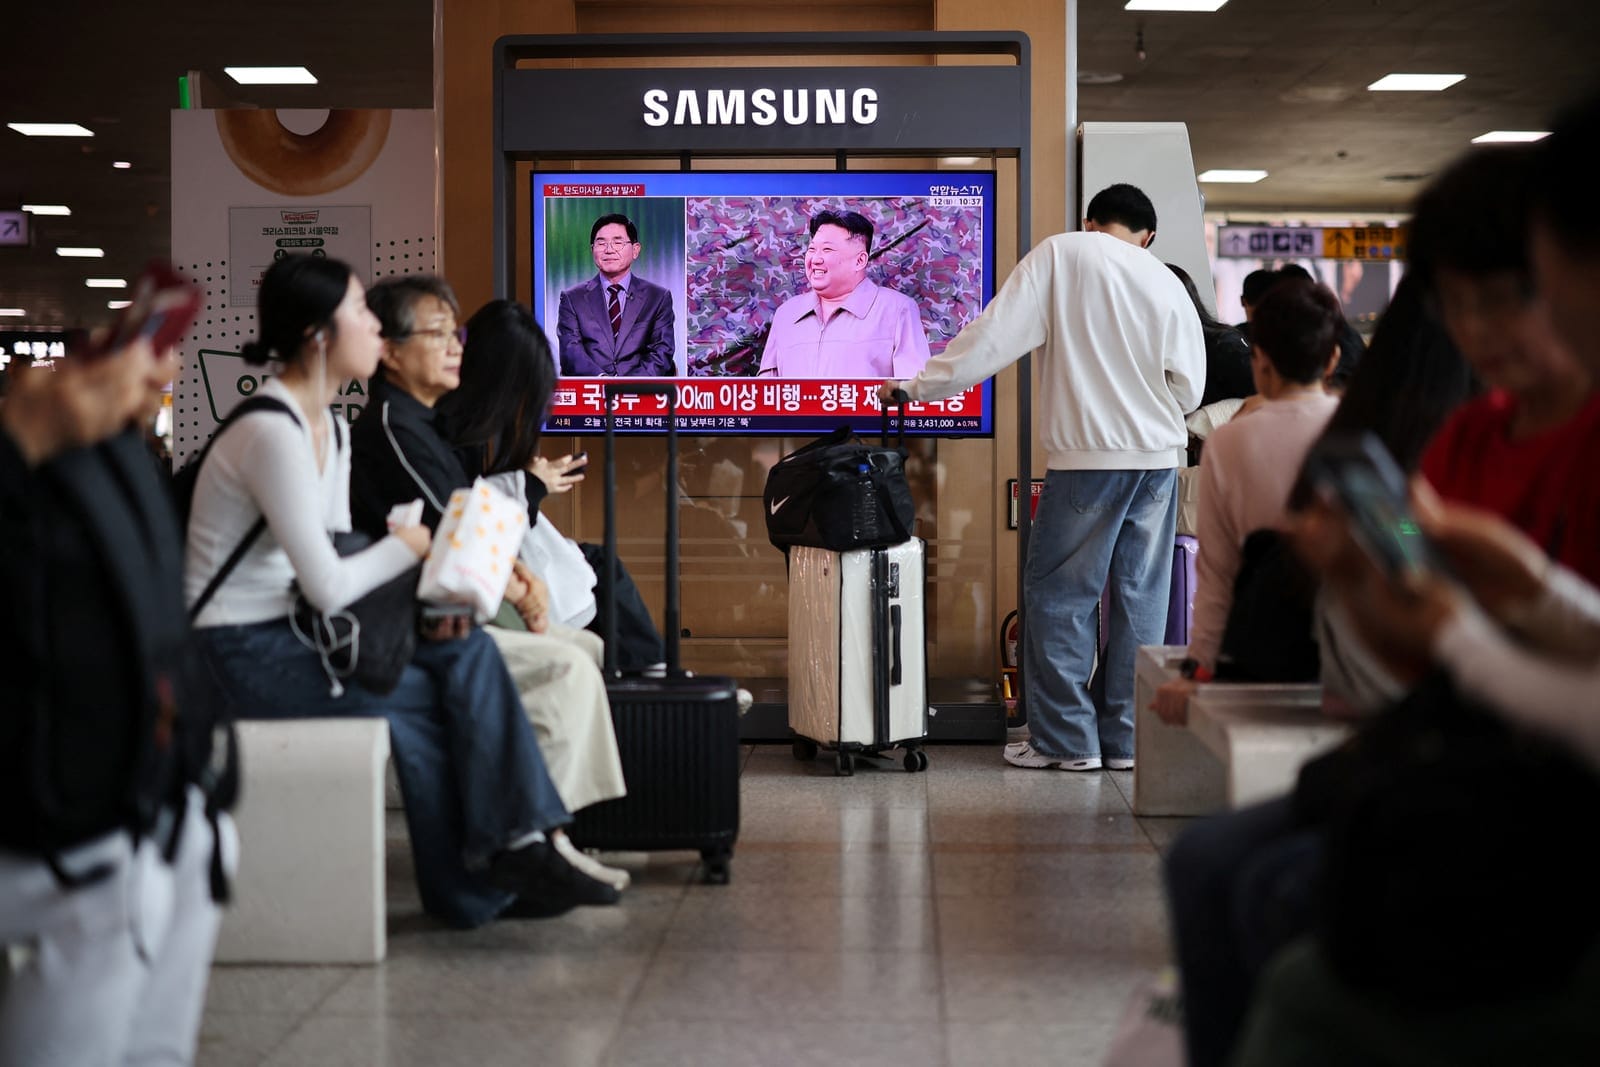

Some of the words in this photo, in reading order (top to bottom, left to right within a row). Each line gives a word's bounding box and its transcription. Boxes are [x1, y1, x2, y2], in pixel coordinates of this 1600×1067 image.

[643, 88, 878, 126] SAMSUNG
[563, 185, 602, 195] 탄도미사일
[929, 185, 983, 196] 연합뉴스TV
[960, 198, 980, 206] 10:37
[720, 384, 758, 411] 이상
[555, 418, 571, 427] 사회
[584, 417, 601, 427] 오늘
[615, 417, 632, 427] 전국
[635, 417, 643, 427] 비
[690, 417, 716, 427] 낮부터
[718, 417, 736, 427] 기온
[918, 419, 954, 428] 3,431,000
